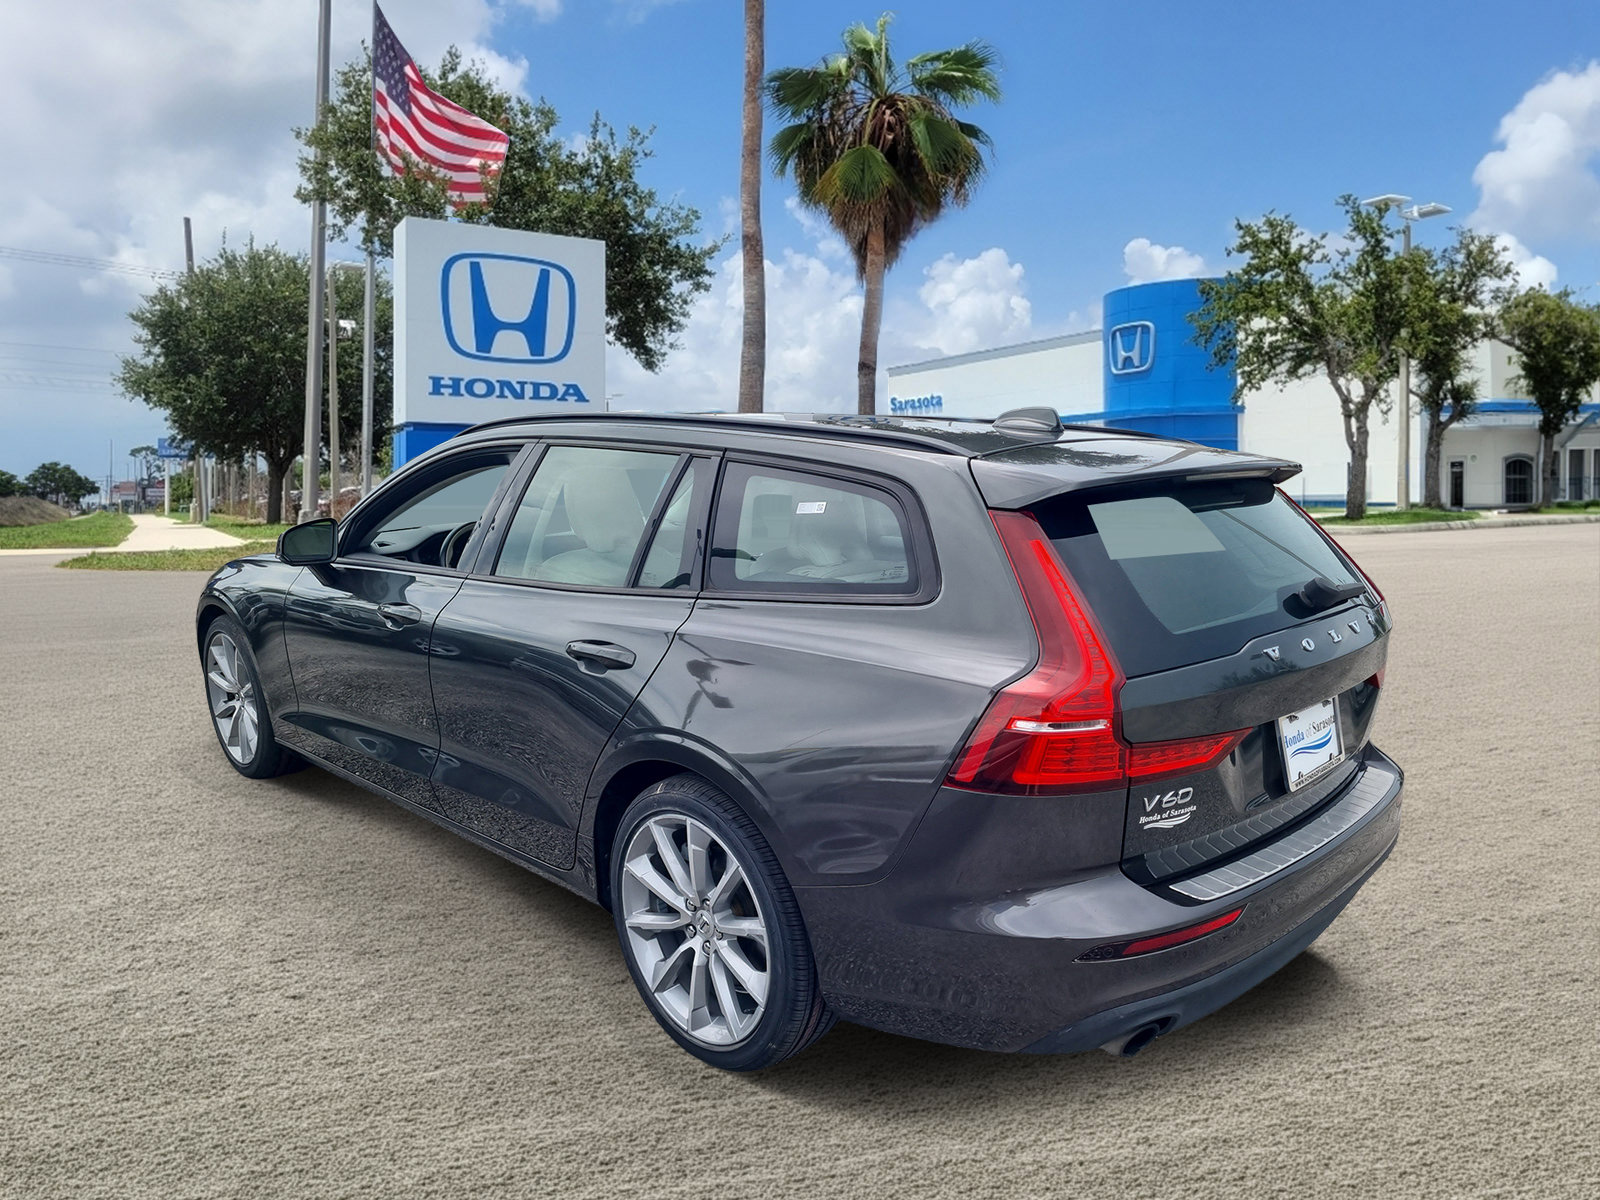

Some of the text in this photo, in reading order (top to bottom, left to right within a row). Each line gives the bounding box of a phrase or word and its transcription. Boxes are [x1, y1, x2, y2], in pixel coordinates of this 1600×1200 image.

[428, 375, 590, 403] HONDA
[890, 393, 943, 412] Sarasota
[1305, 723, 1313, 738] of
[1143, 786, 1194, 813] V60
[1139, 805, 1197, 824] Honda of Sarasota
